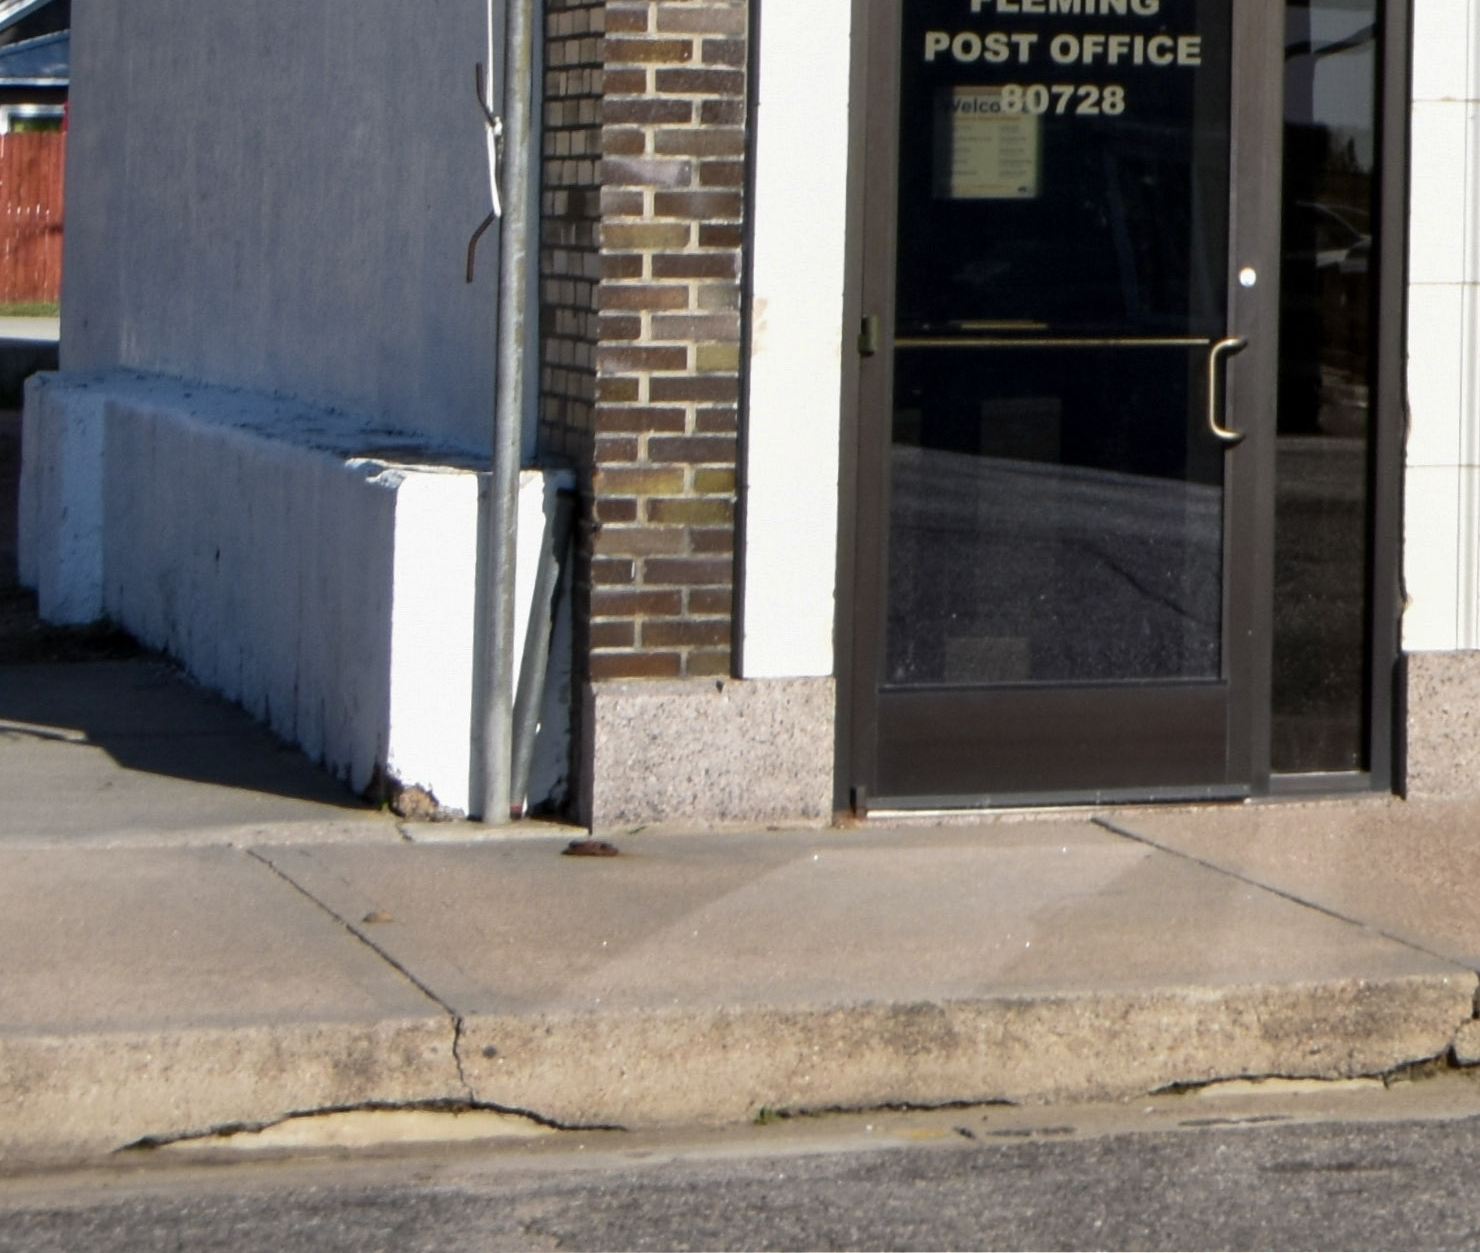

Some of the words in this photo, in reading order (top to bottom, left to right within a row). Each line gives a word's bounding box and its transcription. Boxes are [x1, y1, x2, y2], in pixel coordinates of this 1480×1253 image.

[924, 31, 1038, 63] POST
[1050, 34, 1202, 66] OFFICE
[1000, 84, 1126, 116] 80728
